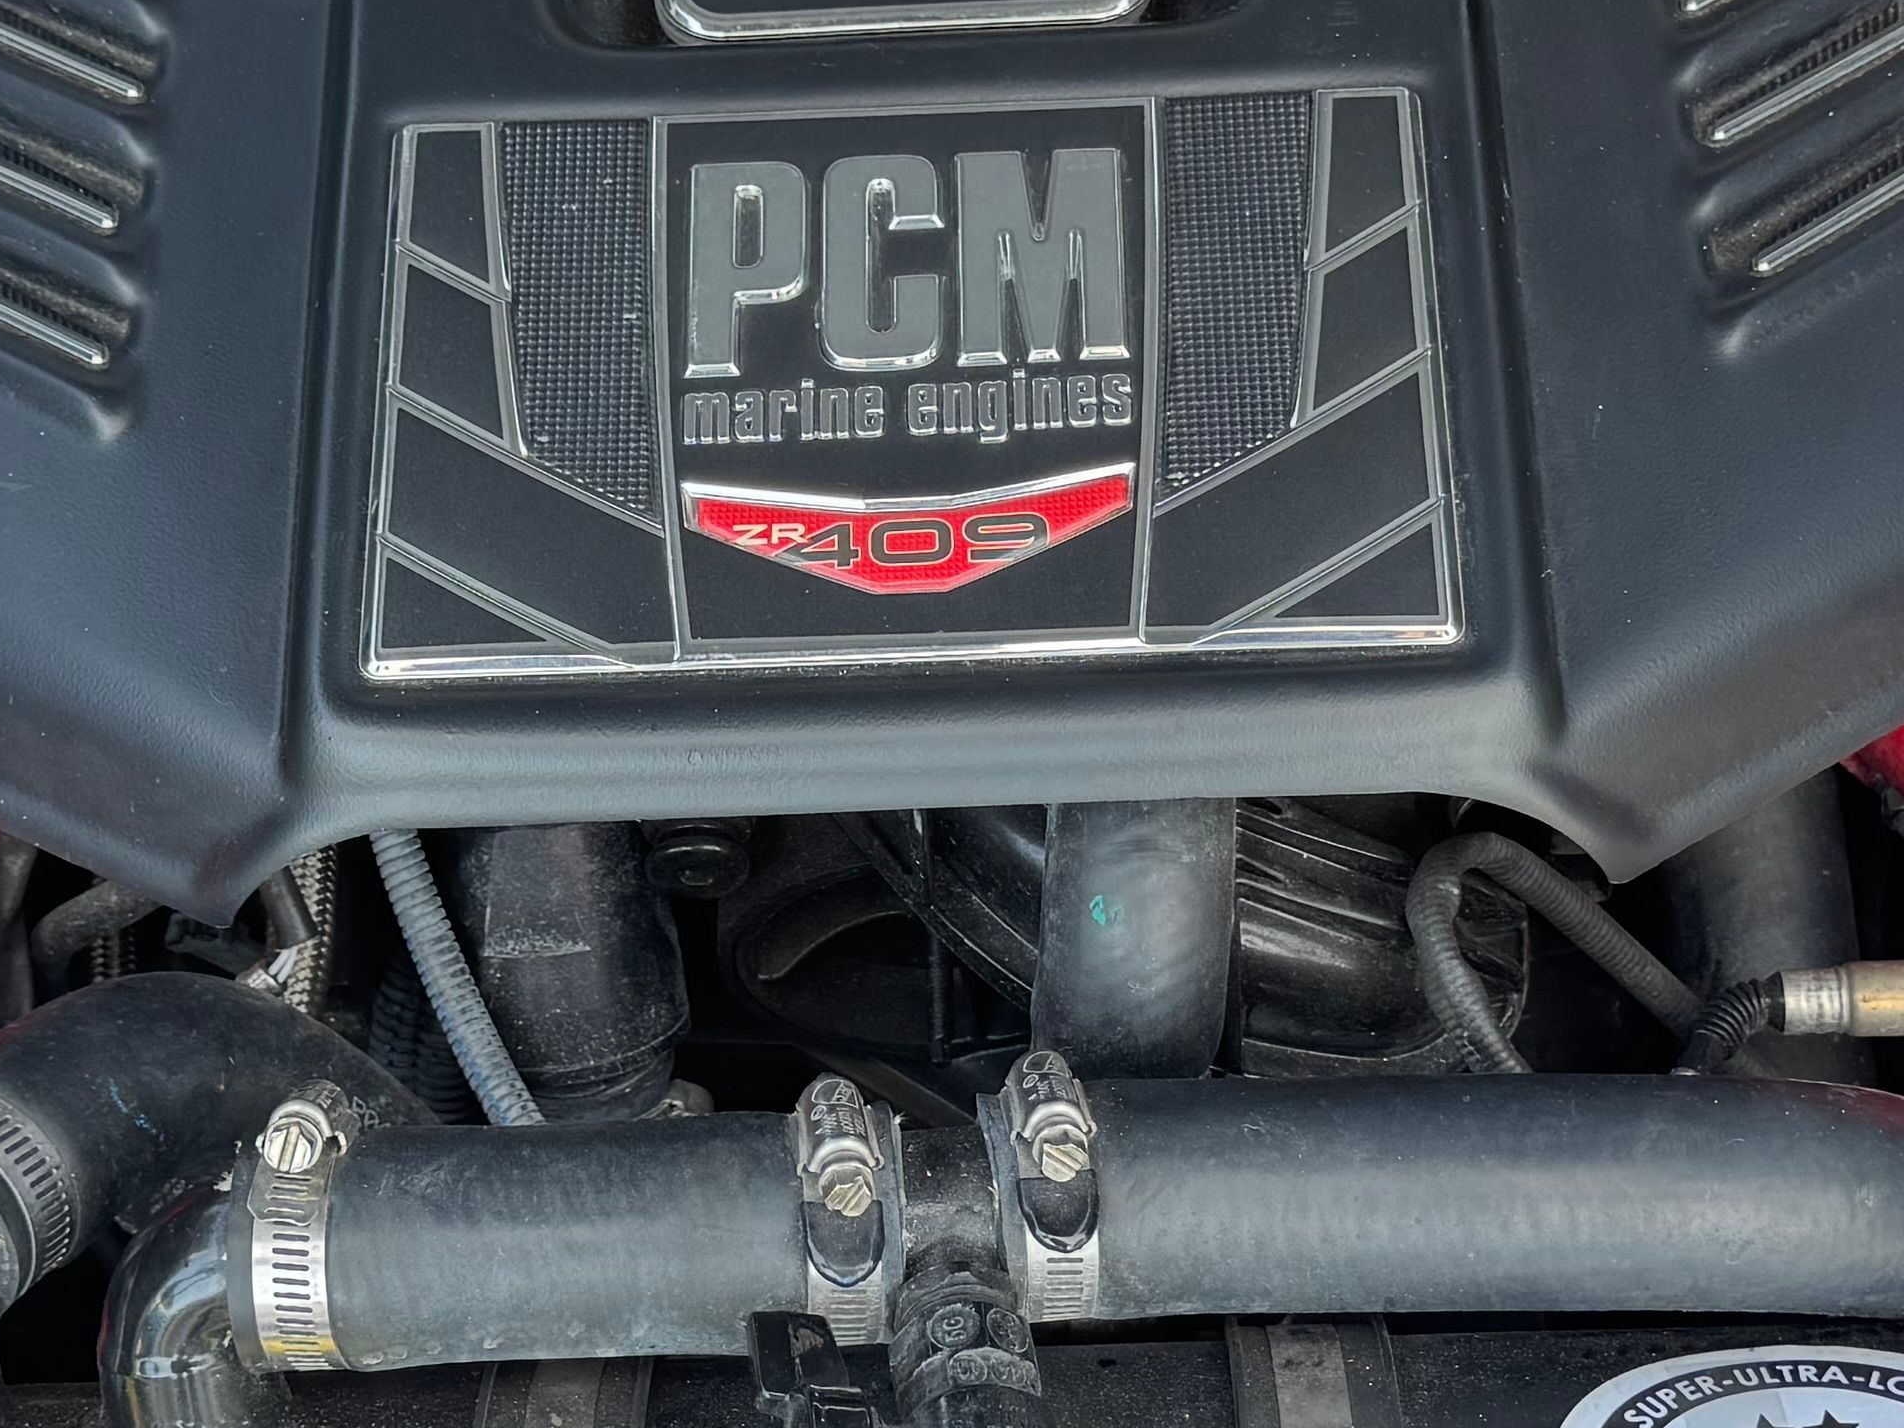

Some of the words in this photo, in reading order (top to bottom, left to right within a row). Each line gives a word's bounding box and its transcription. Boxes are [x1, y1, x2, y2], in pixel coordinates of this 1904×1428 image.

[683, 146, 1132, 380] PCM
[682, 378, 886, 446] marine
[904, 367, 1134, 445] engines
